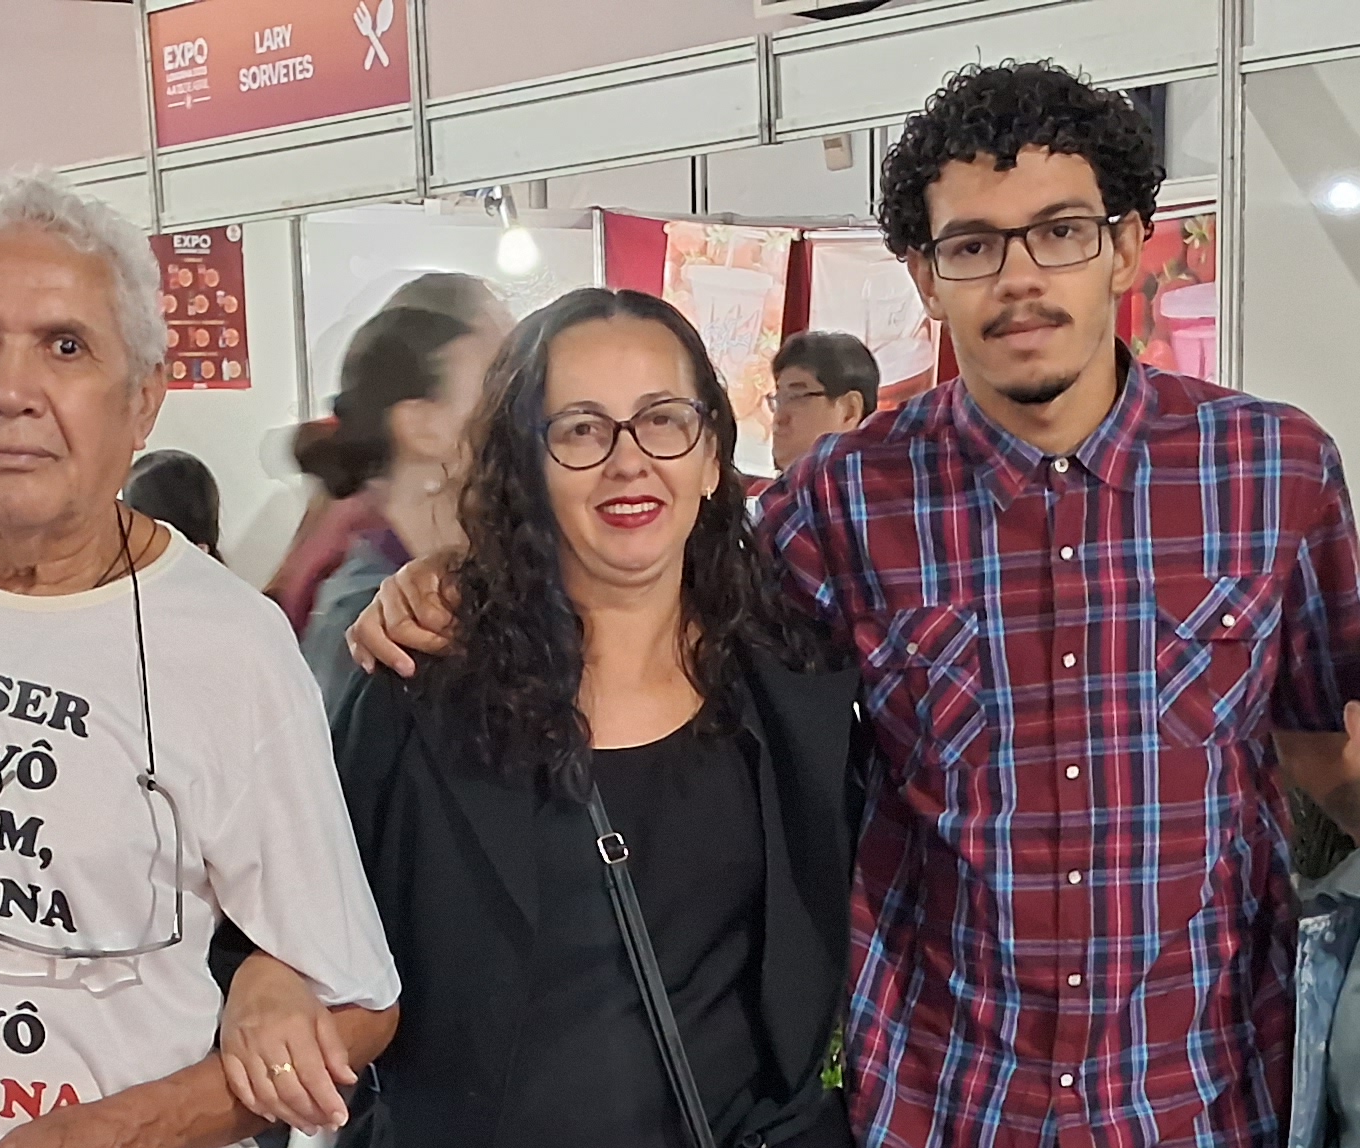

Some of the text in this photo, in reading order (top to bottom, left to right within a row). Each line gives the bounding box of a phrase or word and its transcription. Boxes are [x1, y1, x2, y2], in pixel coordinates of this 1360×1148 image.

[162, 37, 209, 71] EXPO
[253, 23, 293, 55] LARY
[238, 54, 314, 92] SORVETES
[172, 234, 212, 249] EXPO
